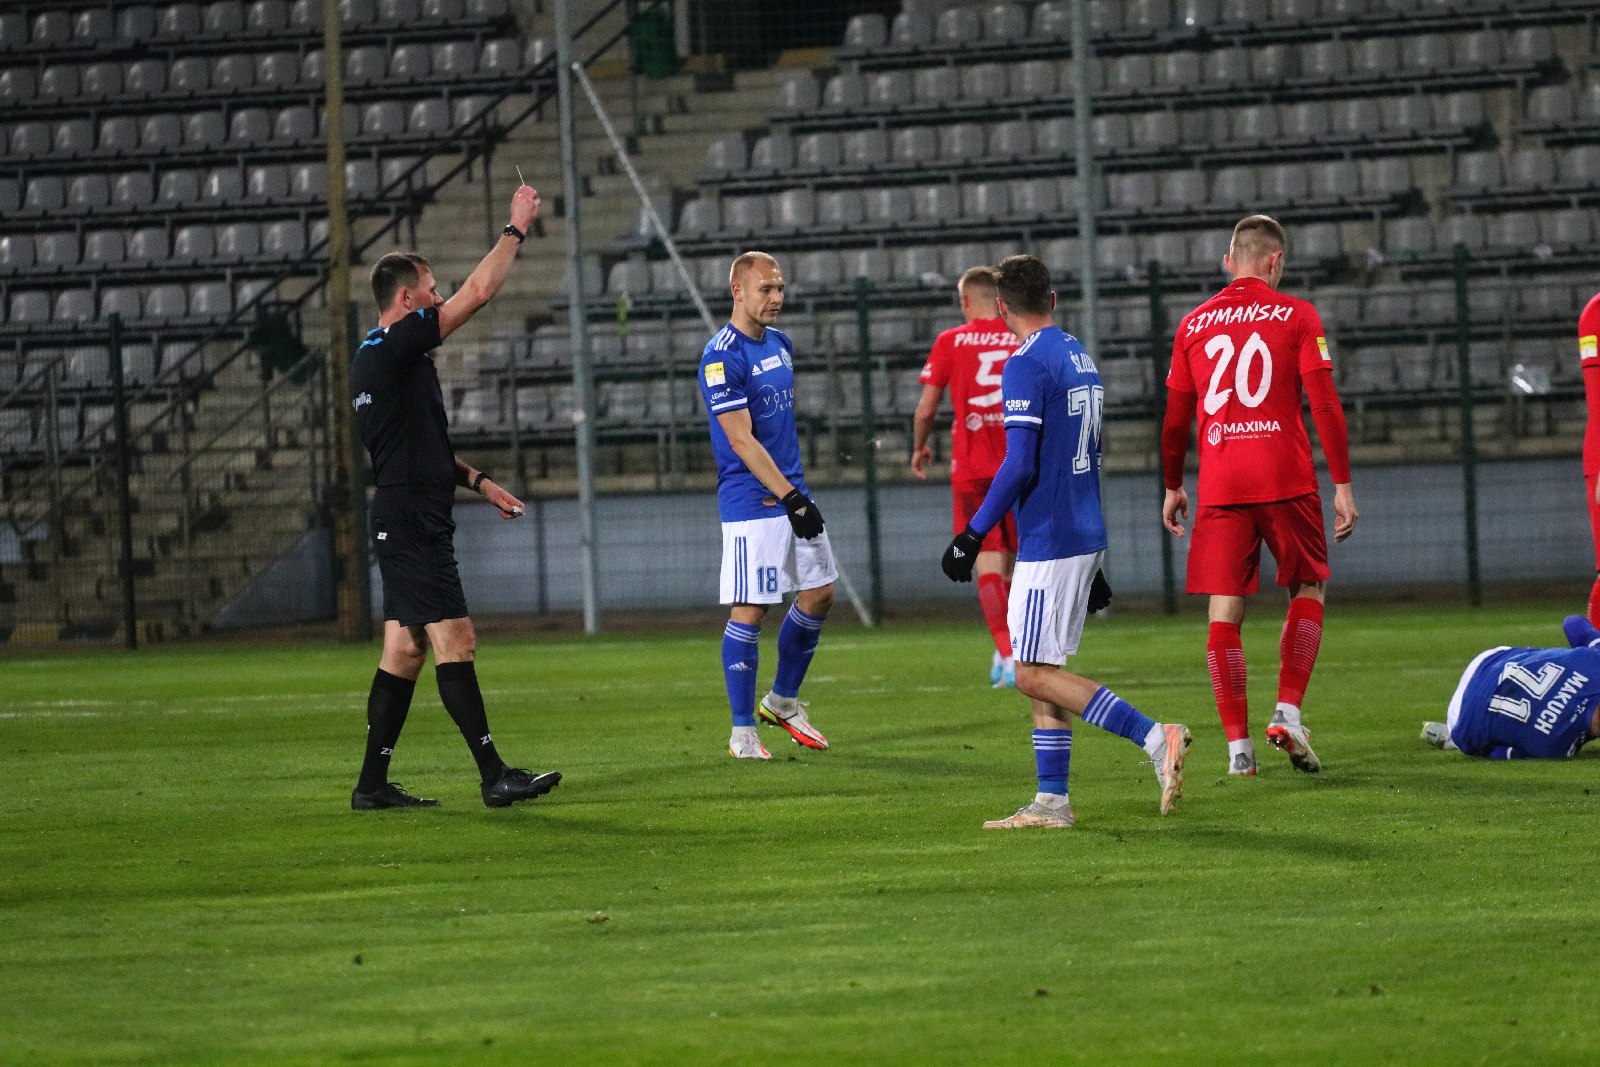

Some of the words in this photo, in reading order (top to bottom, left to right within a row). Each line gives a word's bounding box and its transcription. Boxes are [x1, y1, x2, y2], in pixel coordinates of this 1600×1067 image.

[1186, 301, 1294, 338] SZYMAŃSKI
[953, 332, 1020, 347] PALUSZE
[968, 350, 1010, 408] 5
[1203, 331, 1273, 416] 20
[763, 388, 794, 406] VOTU
[1223, 420, 1282, 435] MAXIMA
[756, 565, 779, 595] 18
[1487, 661, 1566, 724] 71
[1534, 670, 1590, 736] MAKUCH
